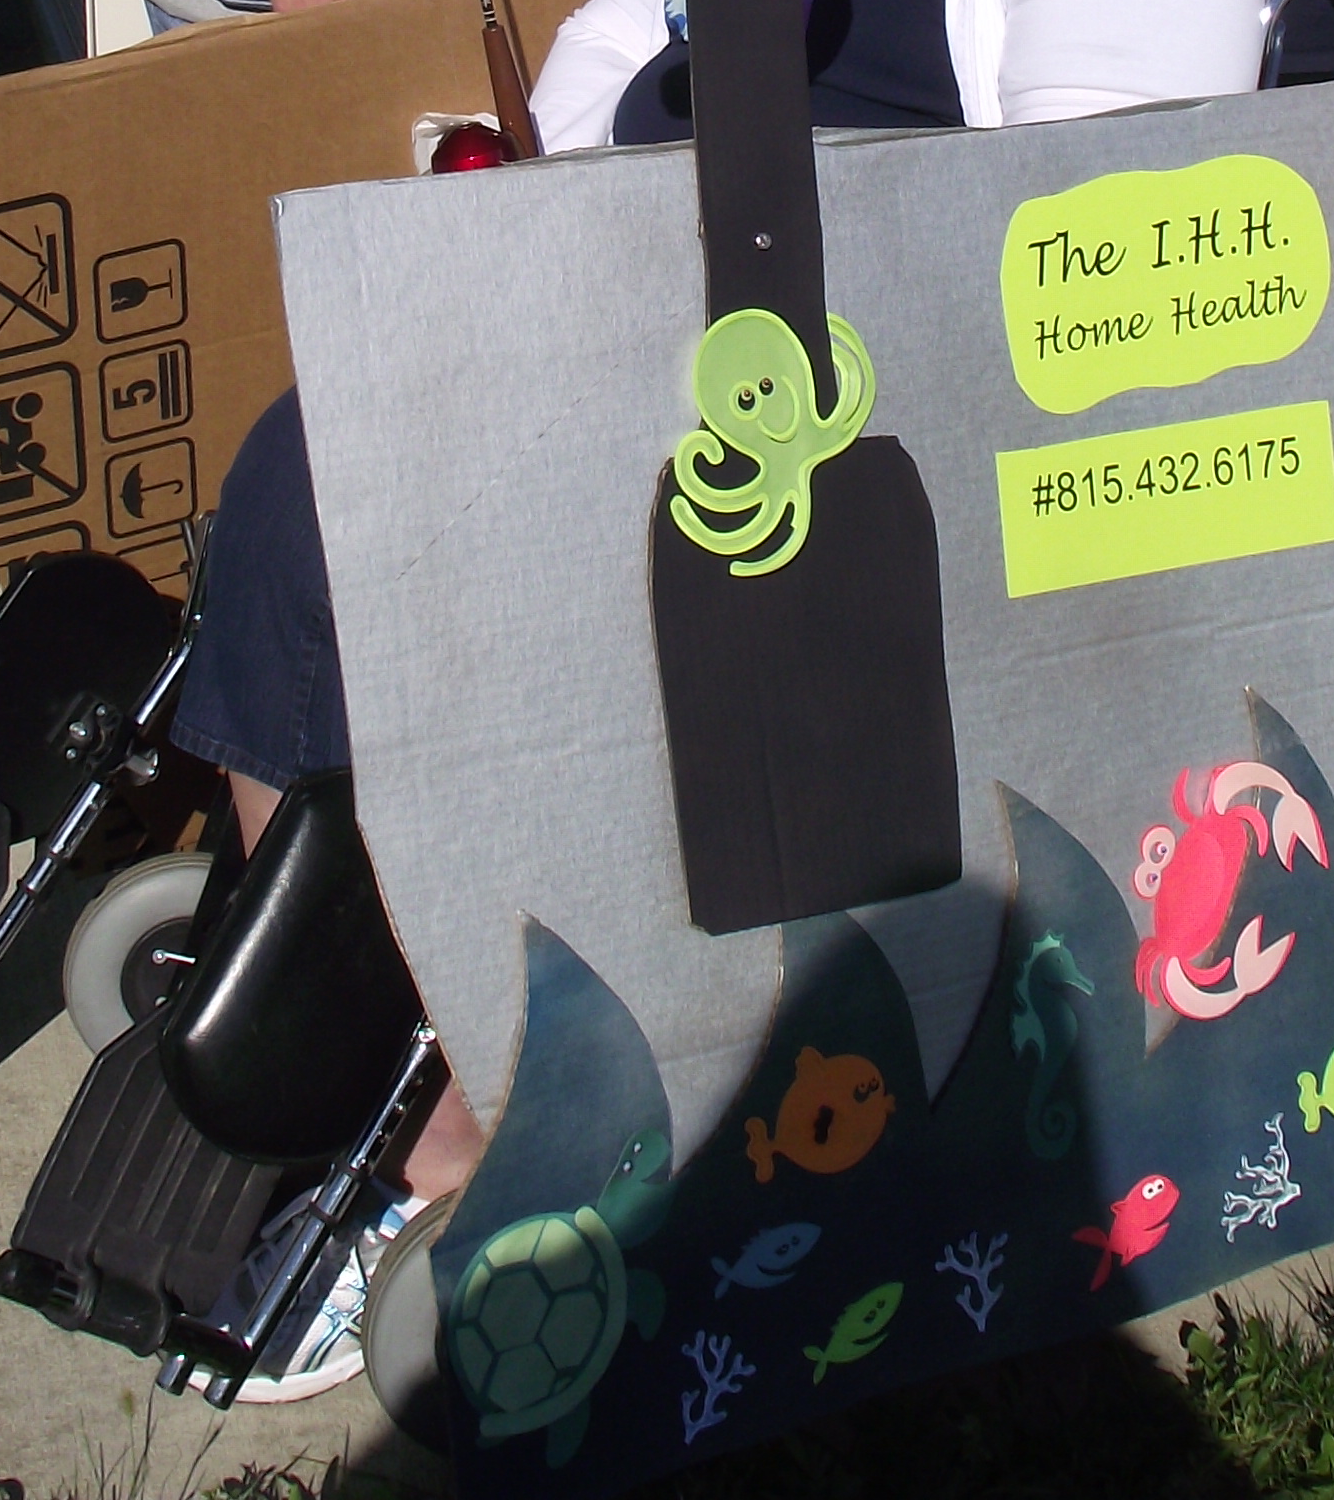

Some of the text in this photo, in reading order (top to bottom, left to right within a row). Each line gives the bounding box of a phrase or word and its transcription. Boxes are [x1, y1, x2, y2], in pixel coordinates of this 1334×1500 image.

[1028, 201, 1290, 287] The I.H.H.
[1034, 274, 1307, 359] Home Health
[113, 379, 156, 410] 5
[1031, 436, 1301, 517] #815.432.6175
